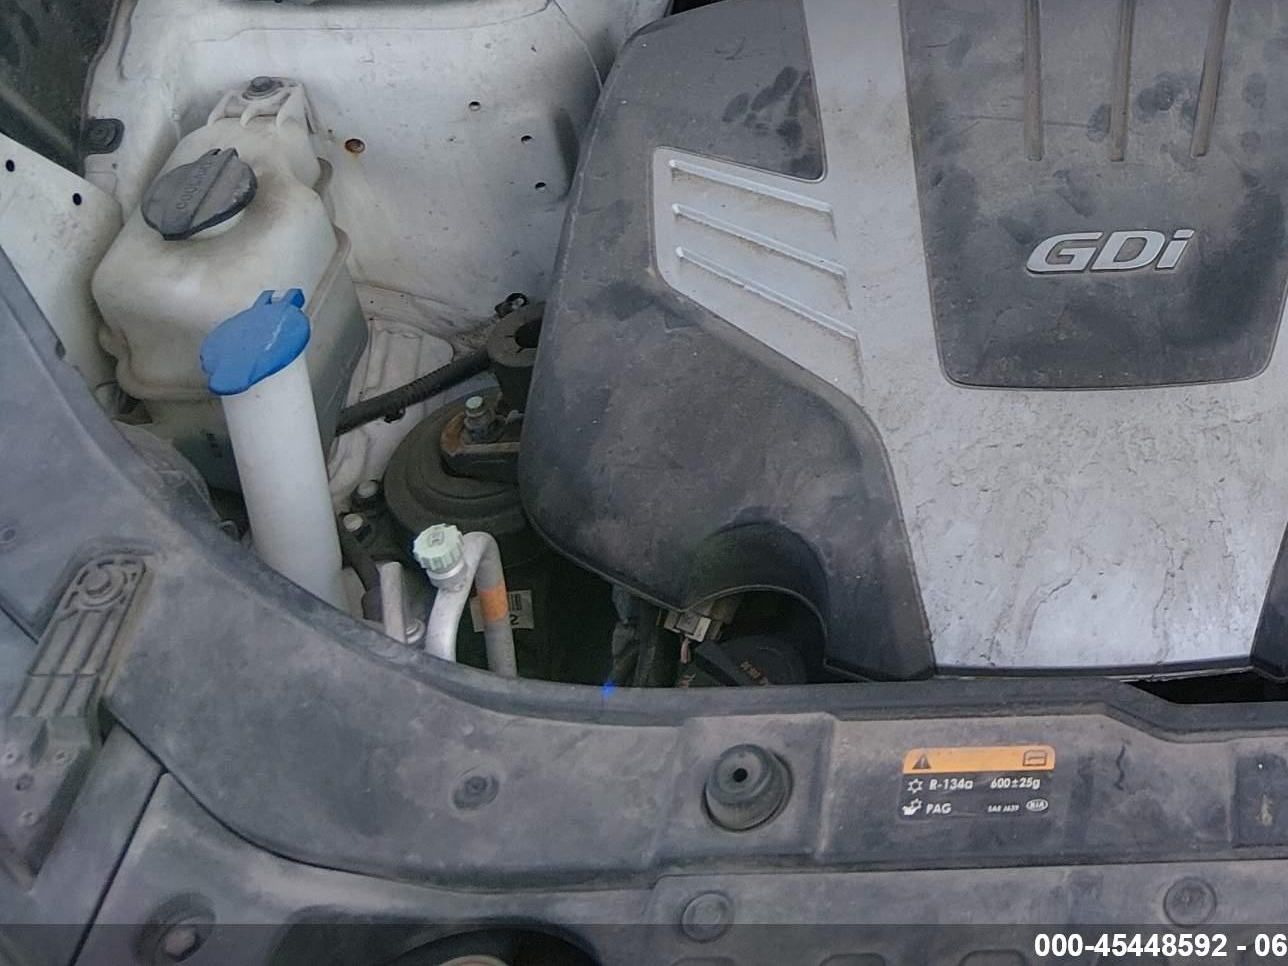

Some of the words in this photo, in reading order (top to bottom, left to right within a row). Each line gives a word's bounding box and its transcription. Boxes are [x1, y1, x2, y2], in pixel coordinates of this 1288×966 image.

[1027, 229, 1195, 274] GDi
[928, 778, 974, 790] R-134a
[990, 777, 1041, 790] 600±25g
[925, 802, 952, 814] PAG
